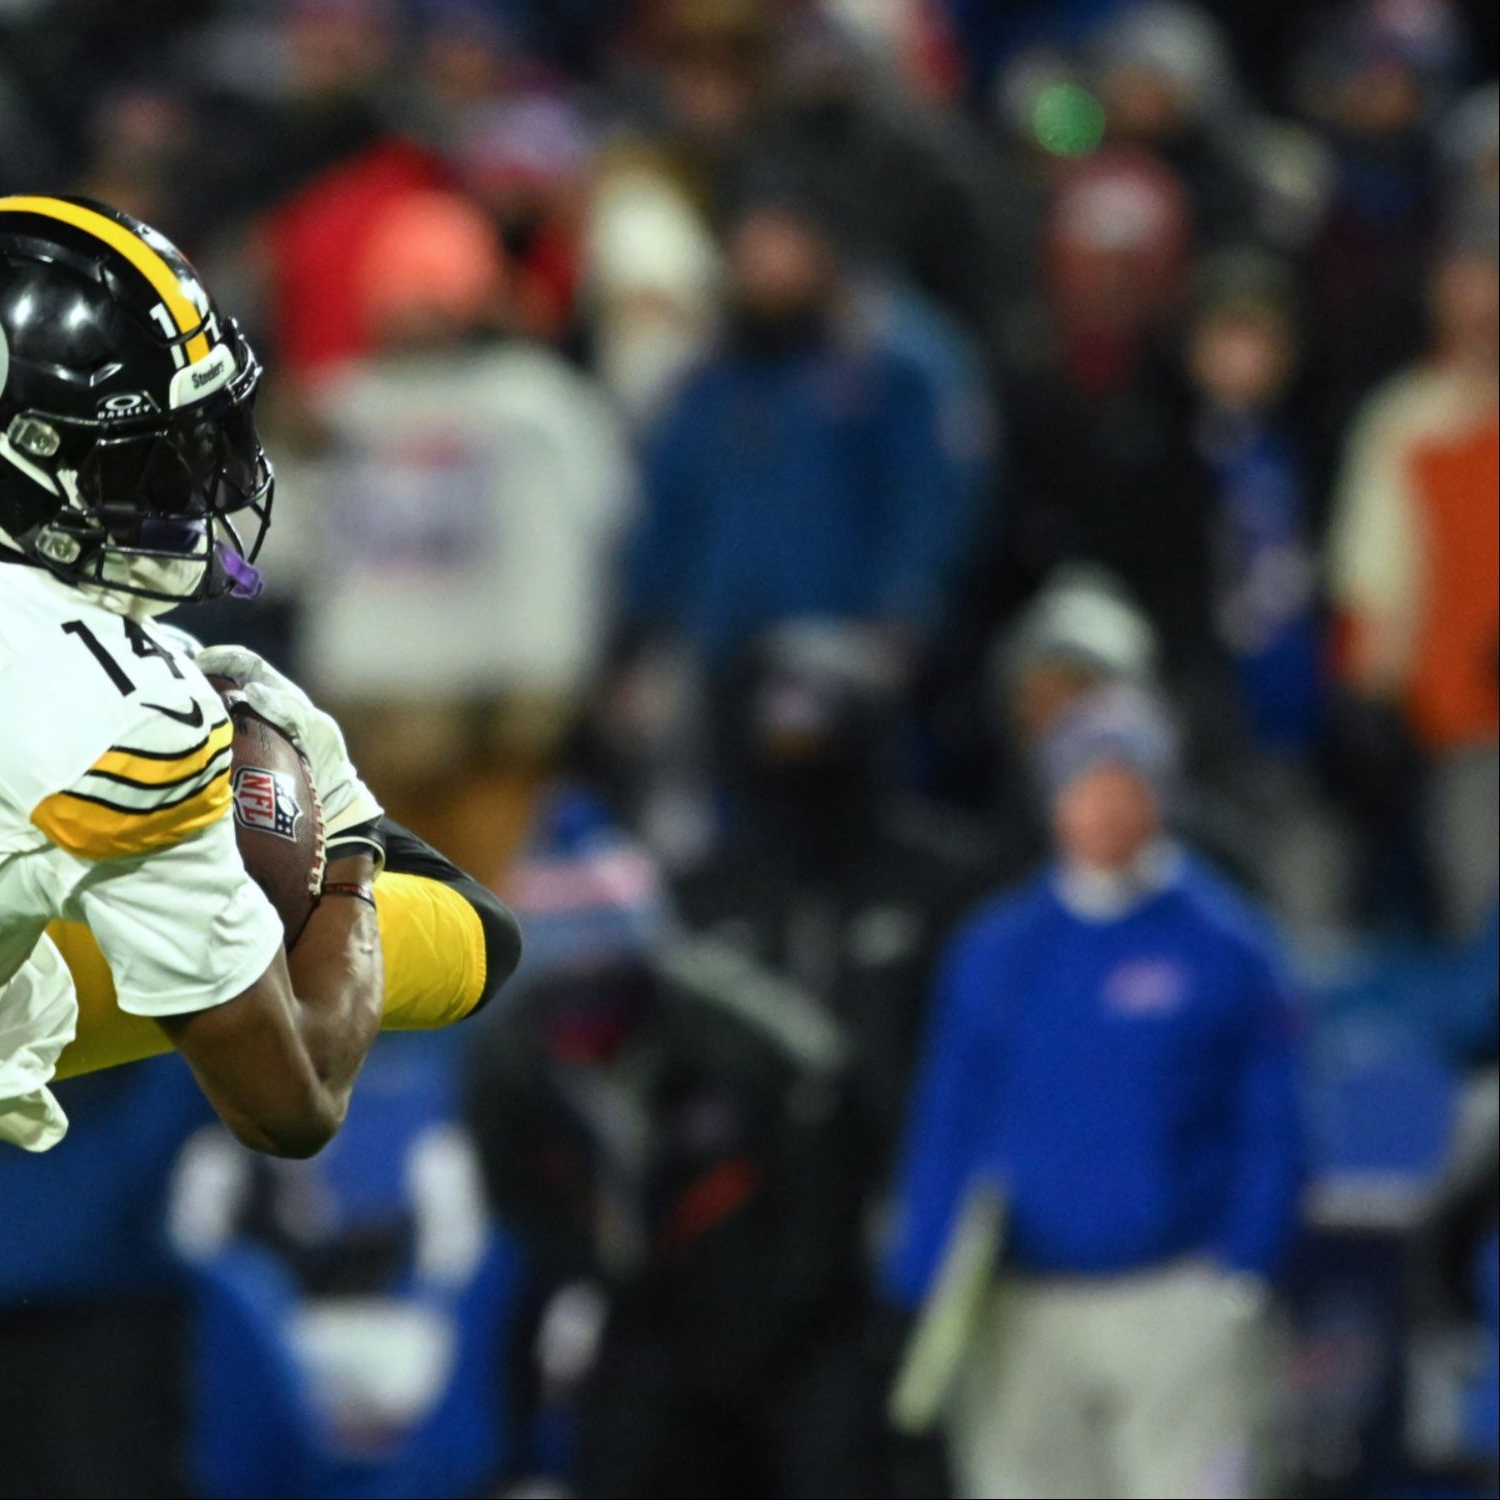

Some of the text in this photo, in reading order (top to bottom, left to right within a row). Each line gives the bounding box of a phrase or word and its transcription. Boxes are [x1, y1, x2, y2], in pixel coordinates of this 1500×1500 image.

[97, 404, 151, 420] OAKLEY
[60, 614, 185, 697] 14
[238, 773, 274, 821] NFL
